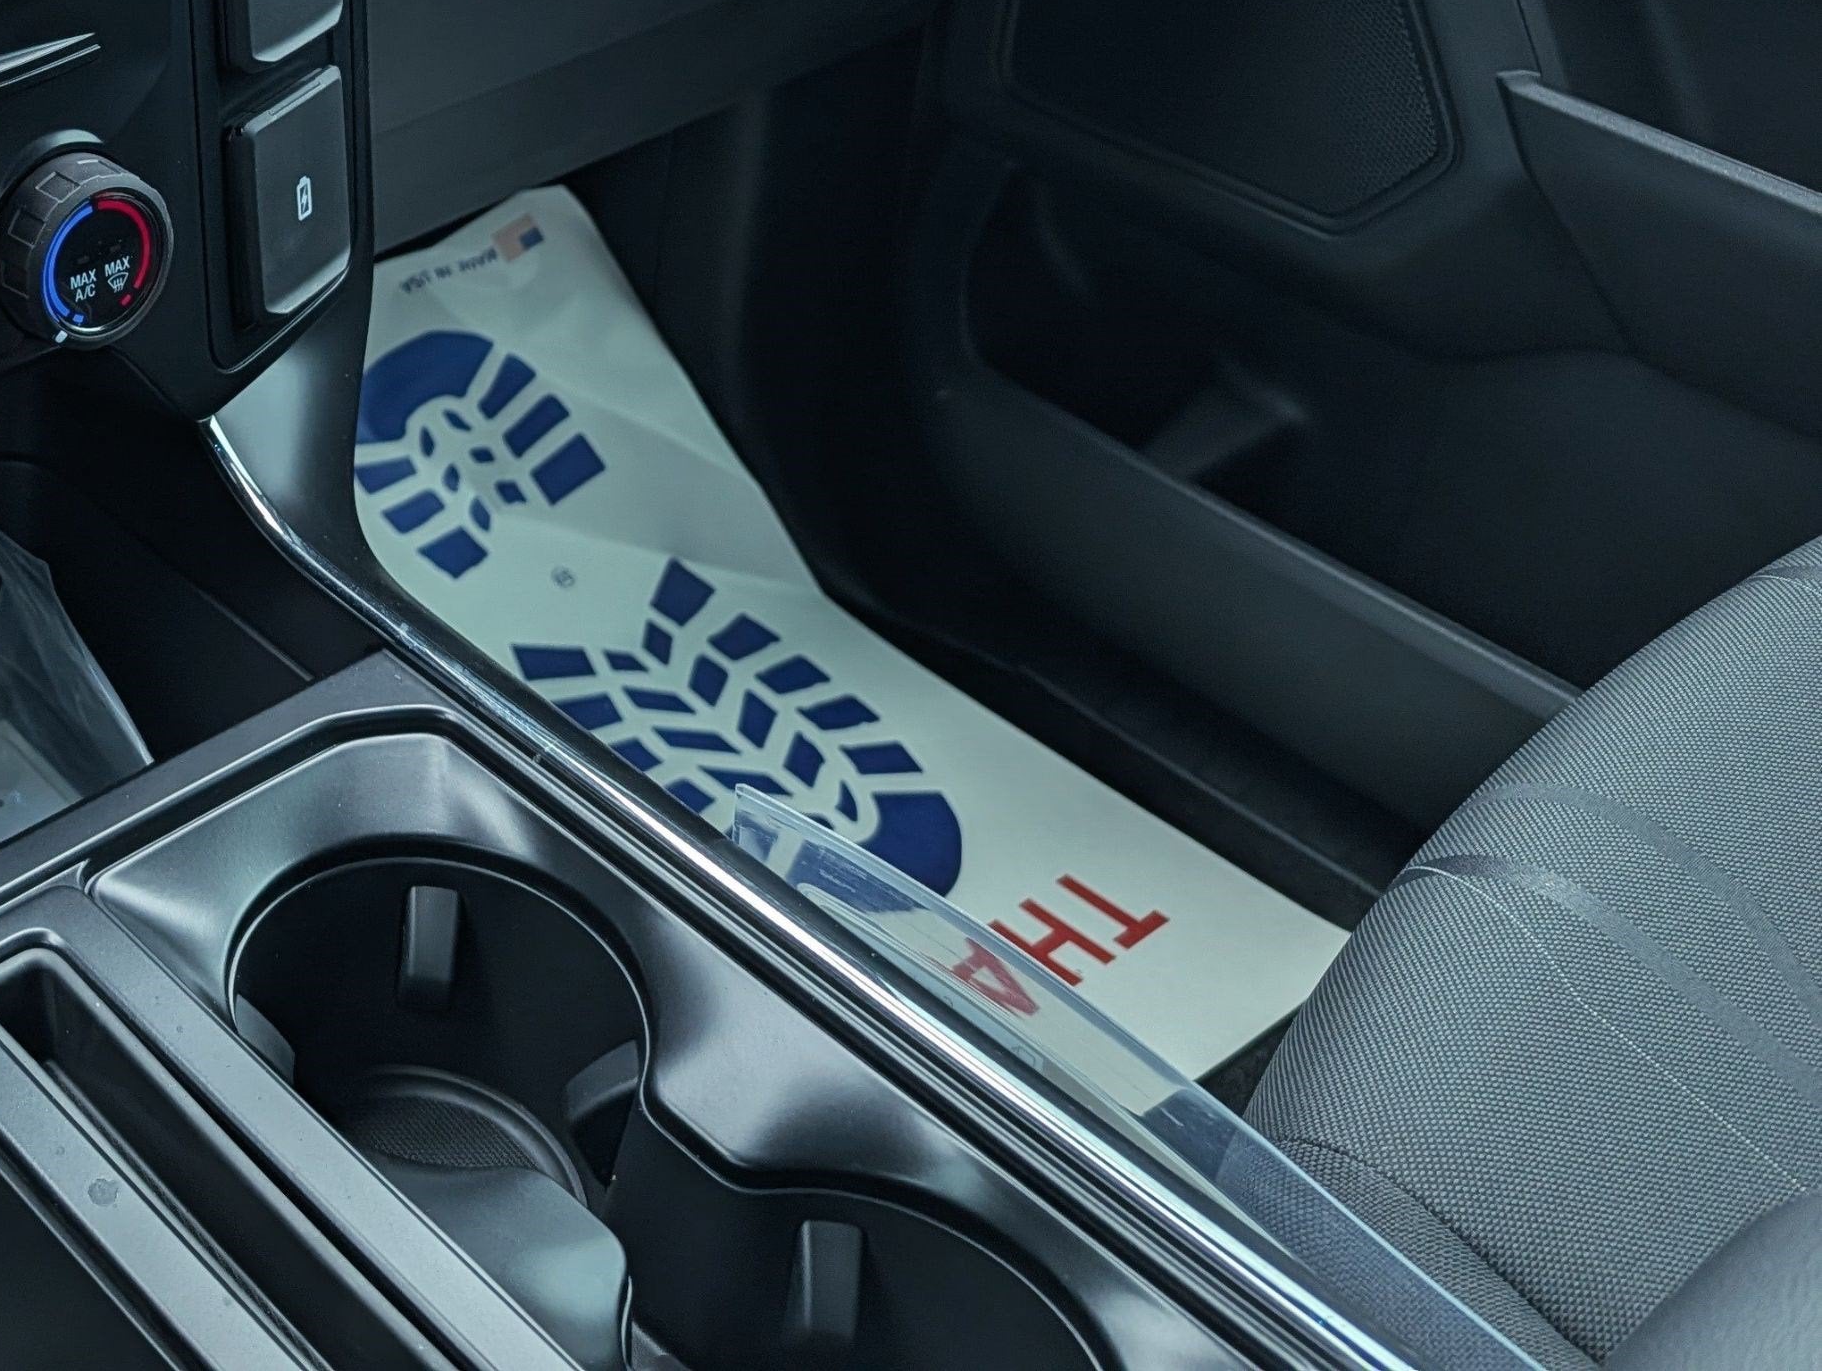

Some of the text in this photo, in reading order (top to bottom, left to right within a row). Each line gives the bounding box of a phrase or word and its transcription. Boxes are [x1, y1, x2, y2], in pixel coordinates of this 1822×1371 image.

[104, 255, 131, 277] MAX
[69, 268, 98, 290] MAX
[74, 285, 97, 303] A/C
